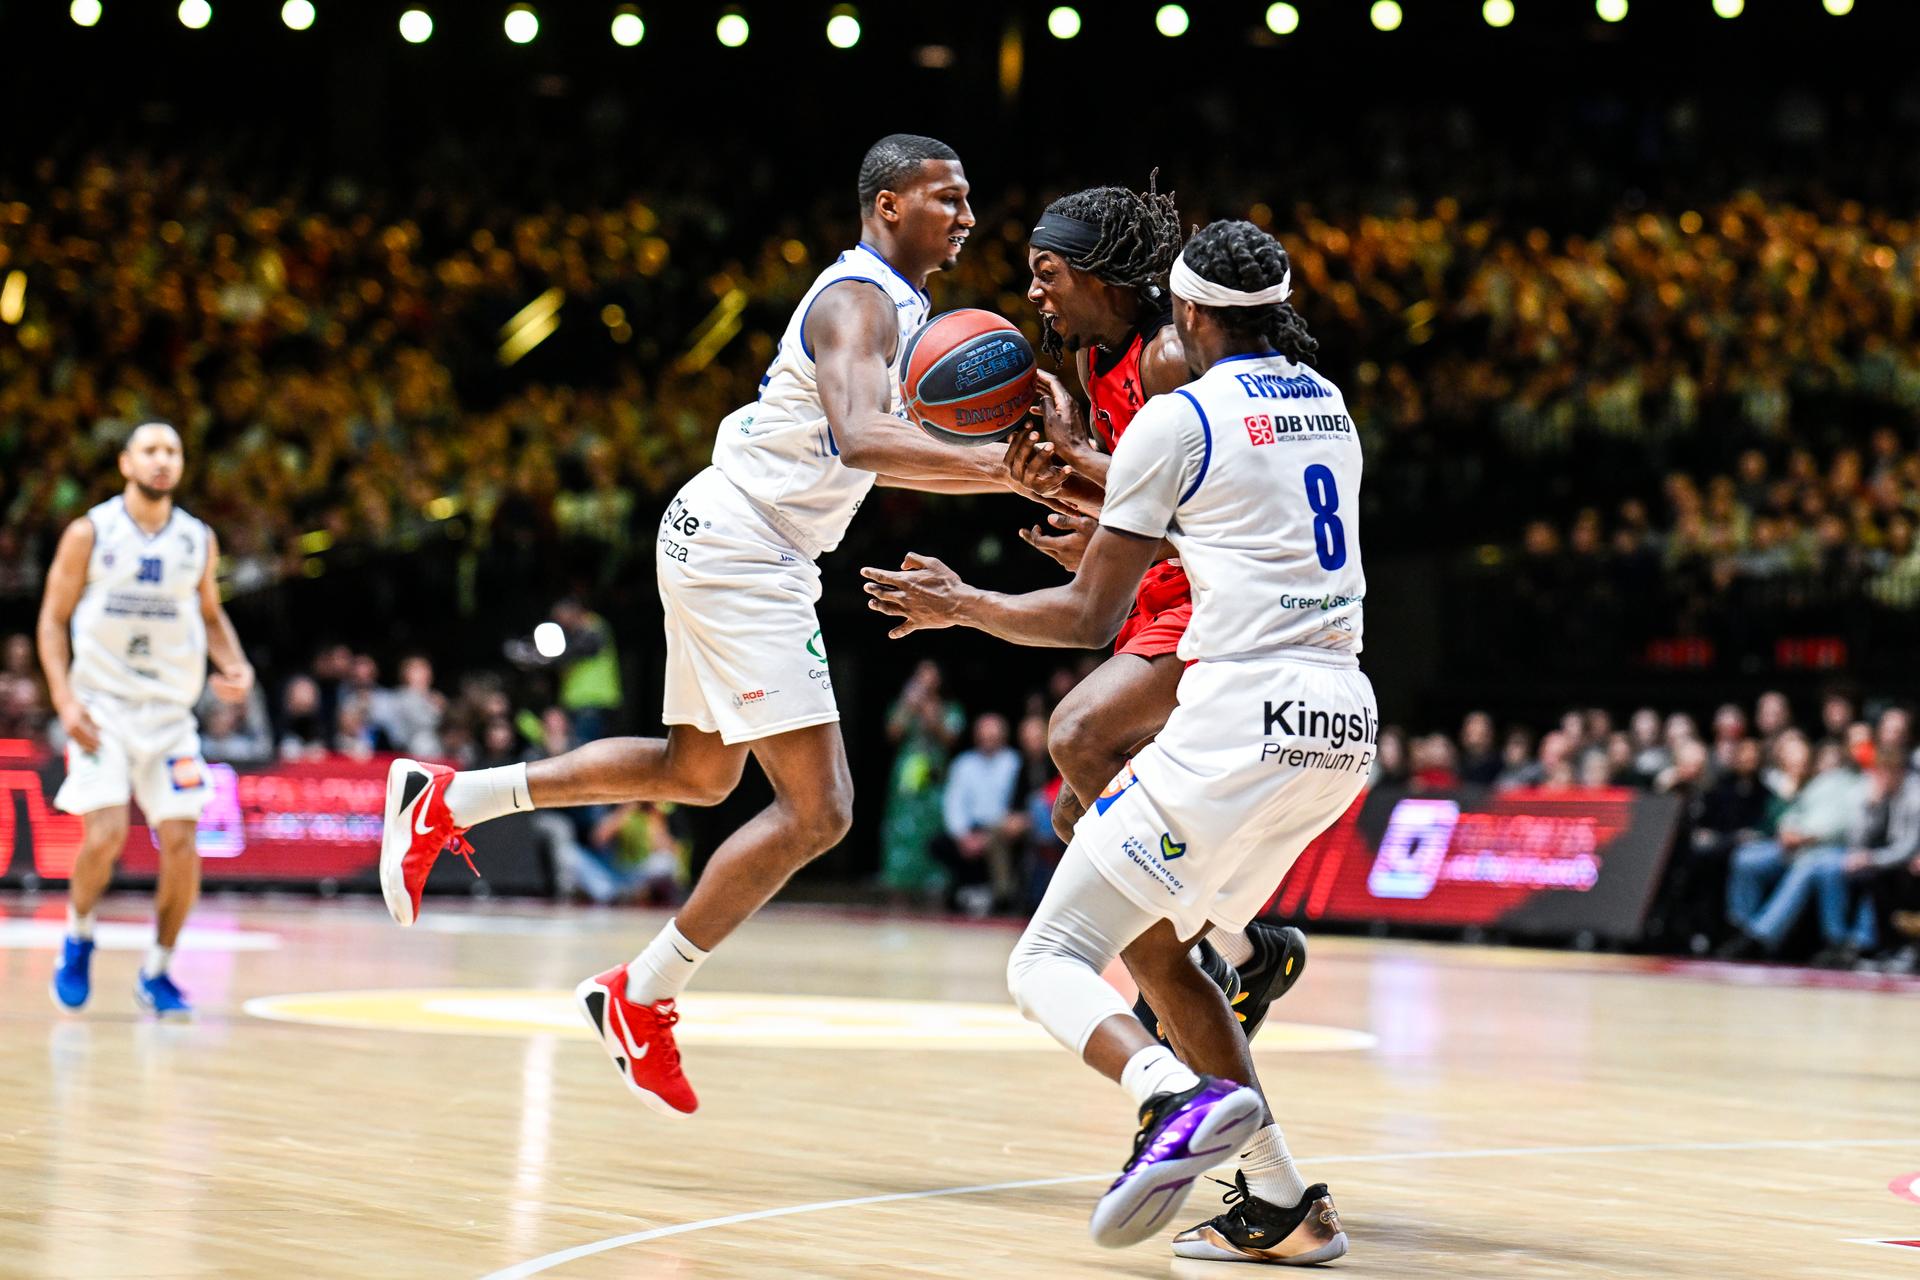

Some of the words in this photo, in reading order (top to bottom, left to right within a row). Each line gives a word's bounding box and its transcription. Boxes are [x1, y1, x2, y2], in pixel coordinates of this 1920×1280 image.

[1274, 416, 1303, 433] DB
[1304, 415, 1350, 433] VIDEO
[1304, 464, 1347, 572] 8
[742, 689, 764, 701] ROS
[1261, 743, 1355, 772] Premium
[1121, 840, 1175, 896] Keule
[1128, 835, 1184, 889] zakenkantoor
